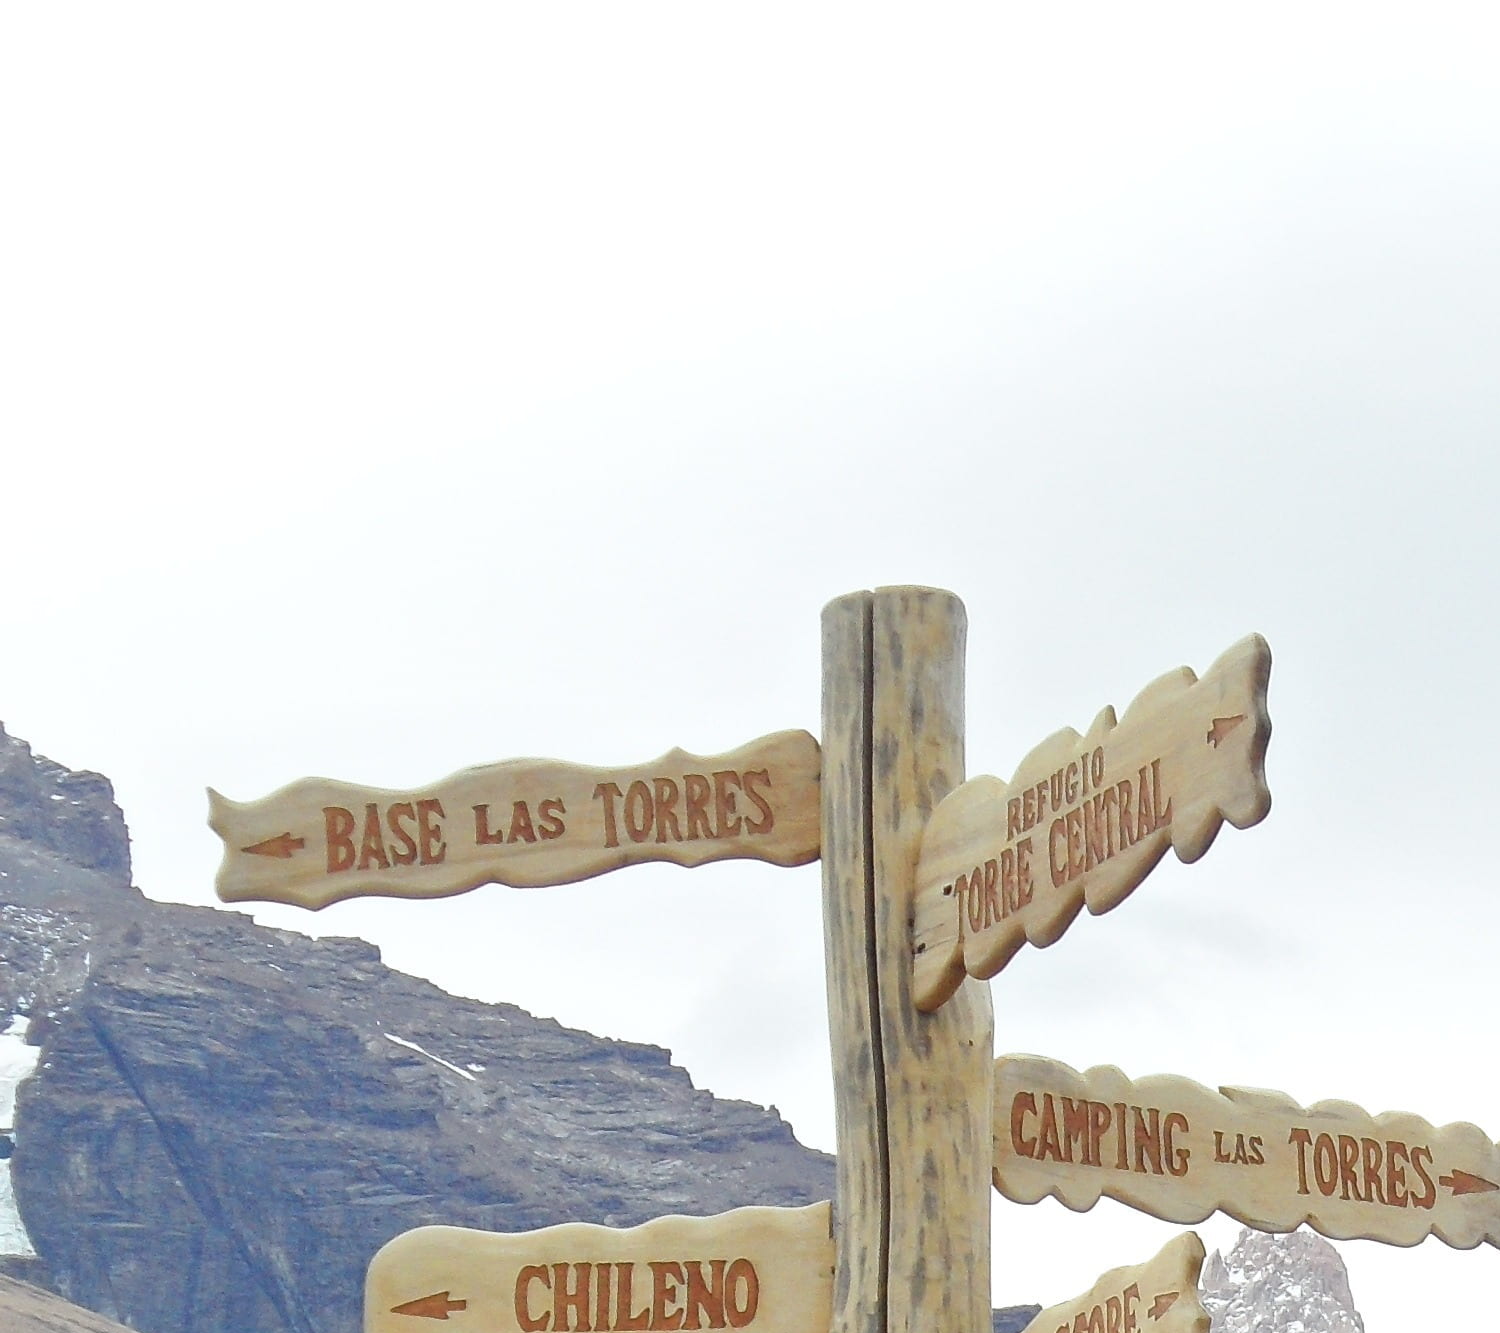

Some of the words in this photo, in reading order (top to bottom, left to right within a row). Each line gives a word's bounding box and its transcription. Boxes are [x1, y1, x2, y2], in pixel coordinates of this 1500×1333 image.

[323, 798, 447, 873] BASE
[472, 799, 566, 845] LAS
[592, 769, 775, 848] TORRES
[1006, 746, 1105, 841] REFUGIO
[954, 837, 1034, 943] TORRE
[1048, 758, 1173, 888] CENTRAL
[1011, 1091, 1191, 1177] CAMPING
[1213, 1130, 1265, 1165] LAS
[1288, 1127, 1437, 1210] TORRES
[514, 1258, 760, 1333] CHILENO
